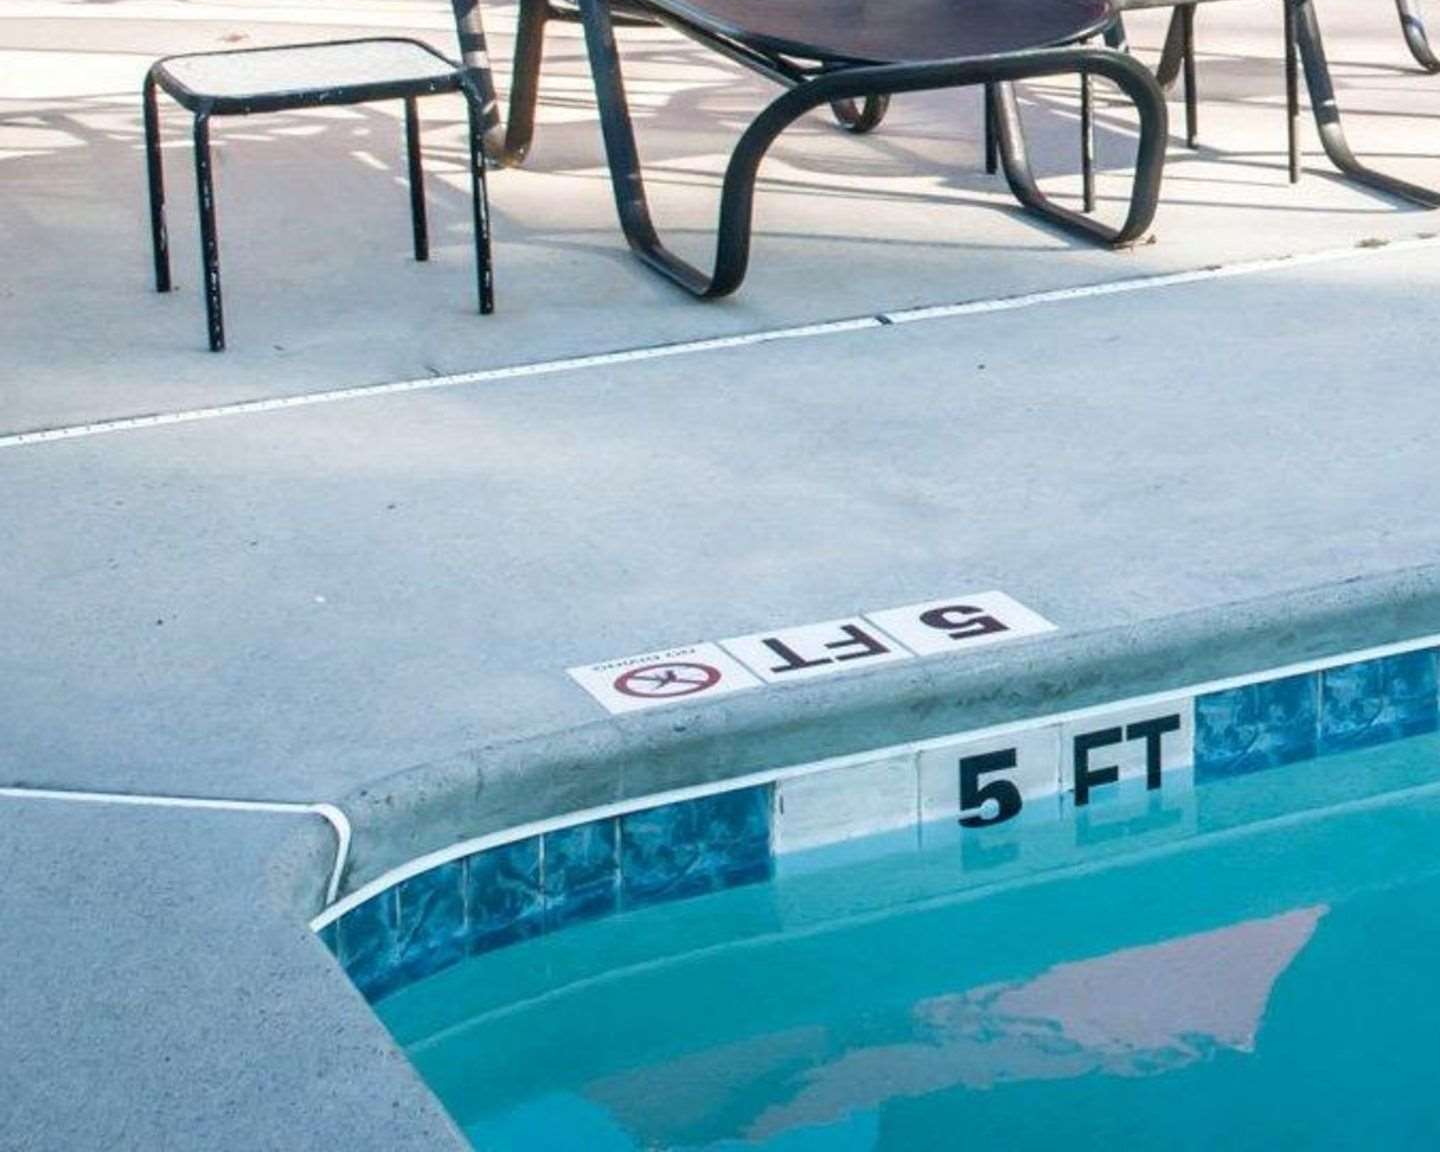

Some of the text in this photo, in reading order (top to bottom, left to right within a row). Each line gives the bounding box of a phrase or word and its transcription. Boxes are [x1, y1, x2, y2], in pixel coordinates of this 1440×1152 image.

[762, 605, 1010, 673] 5 FT
[958, 713, 1180, 828] 5 FT
